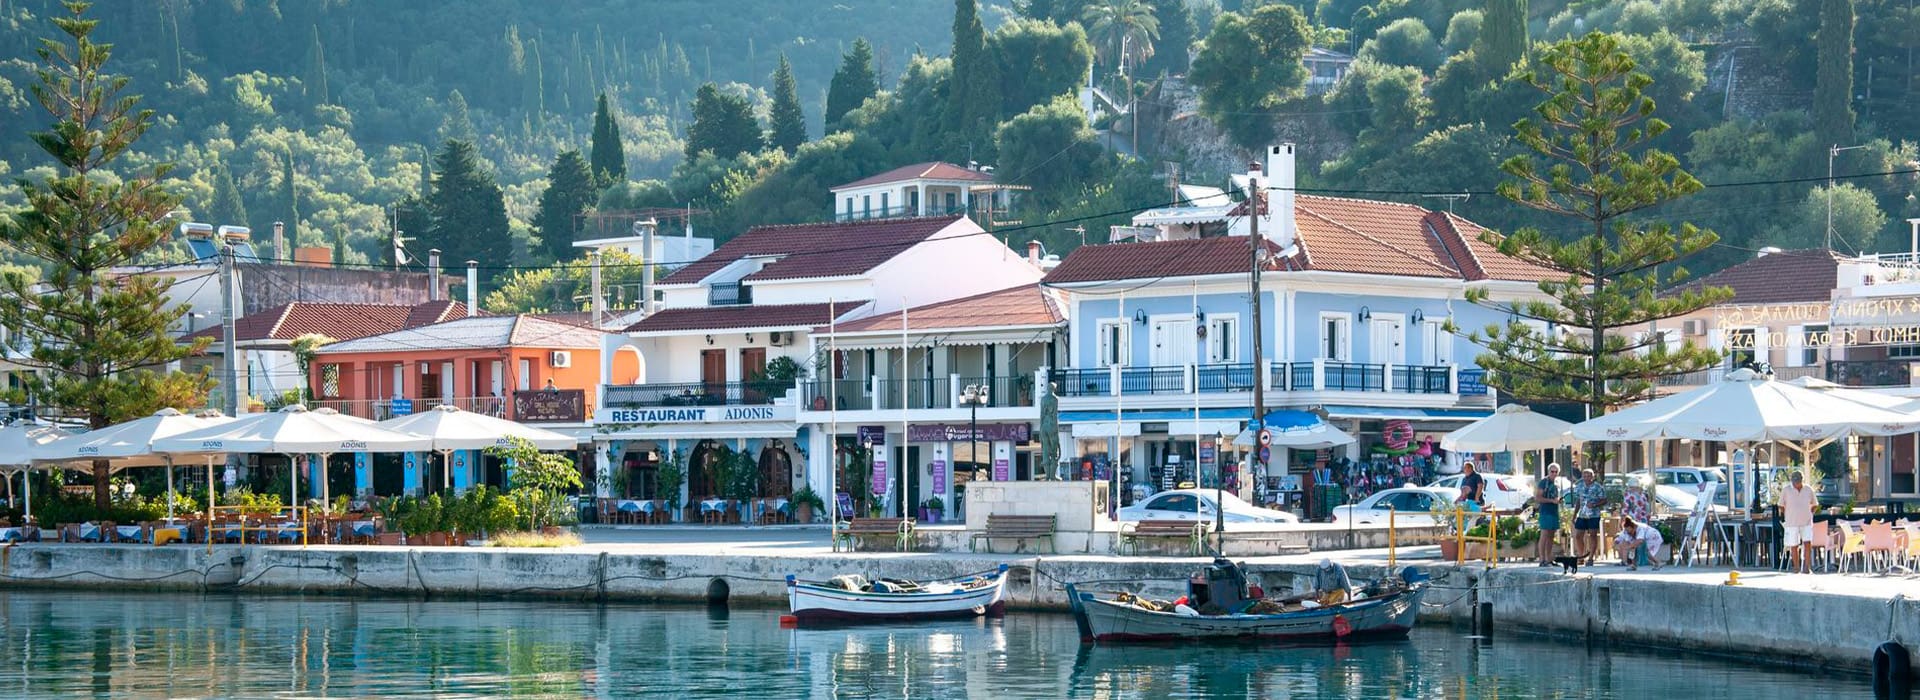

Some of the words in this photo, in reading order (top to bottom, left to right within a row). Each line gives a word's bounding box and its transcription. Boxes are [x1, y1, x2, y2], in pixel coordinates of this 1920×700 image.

[612, 409, 706, 422] RESTAURANT
[725, 407, 774, 420] ADONIS
[202, 440, 223, 448] ADONIS
[340, 441, 367, 449] ADONIS
[78, 446, 99, 454] ADONIS
